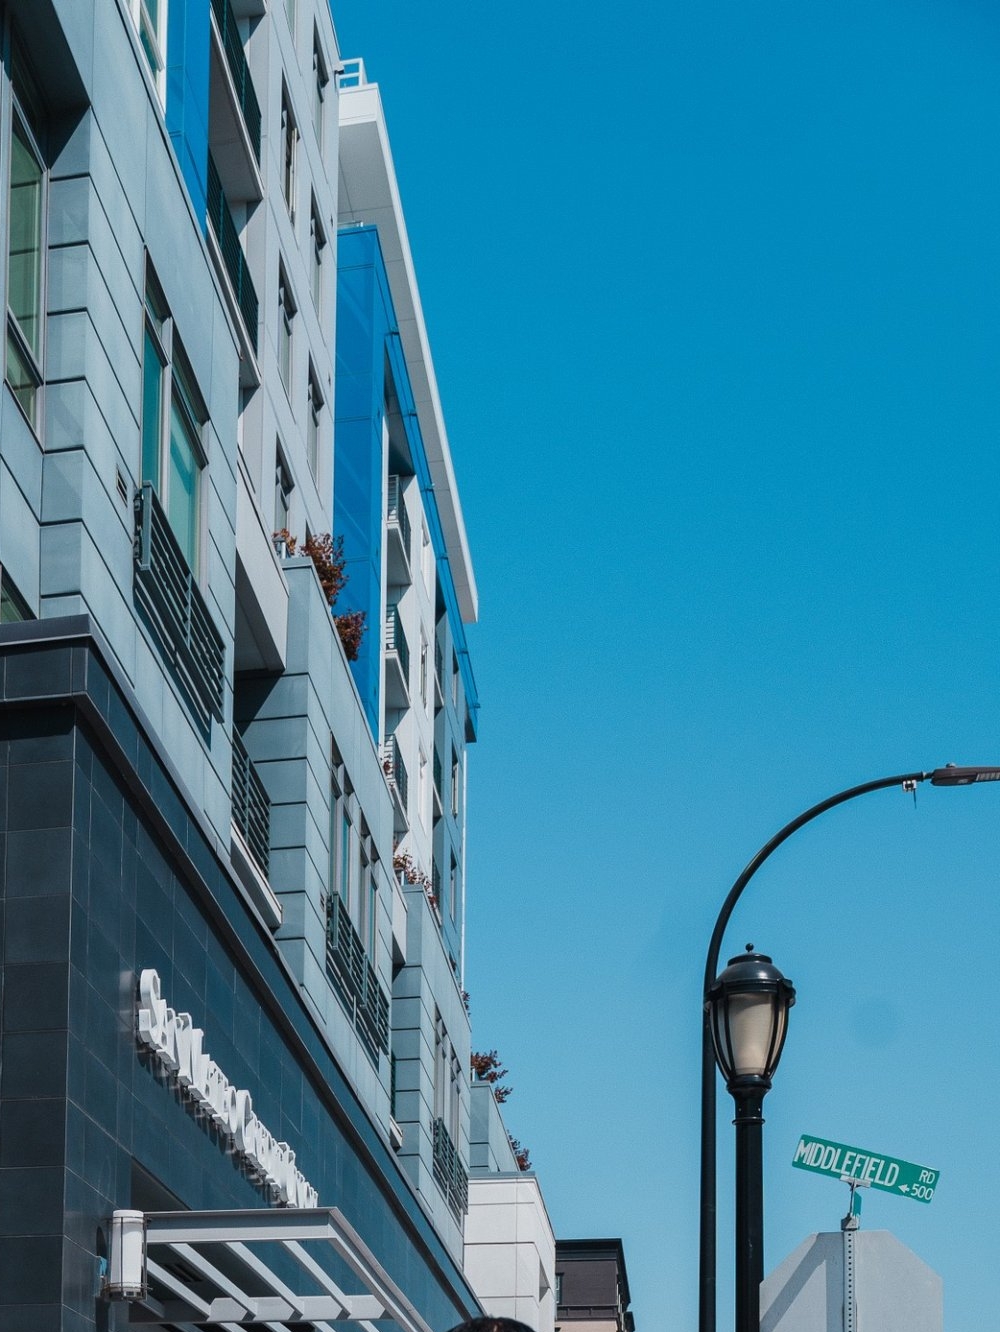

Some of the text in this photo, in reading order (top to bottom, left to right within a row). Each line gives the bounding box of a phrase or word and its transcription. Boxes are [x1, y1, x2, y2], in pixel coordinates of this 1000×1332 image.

[794, 1140, 936, 1186] MIDDLEFIELD RD
[910, 1183, 934, 1201] 500
